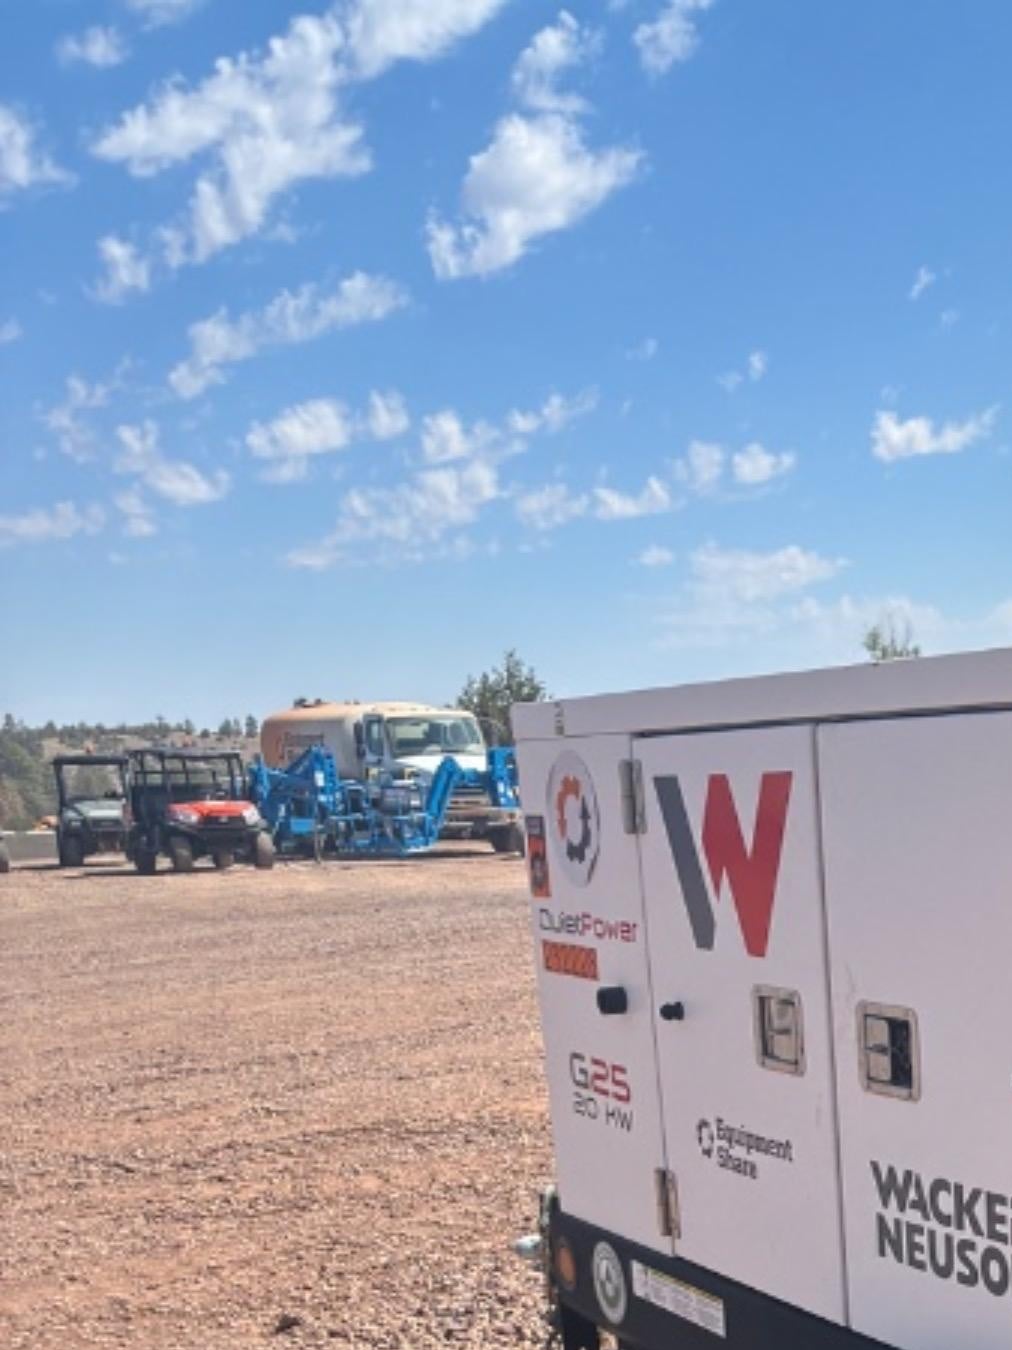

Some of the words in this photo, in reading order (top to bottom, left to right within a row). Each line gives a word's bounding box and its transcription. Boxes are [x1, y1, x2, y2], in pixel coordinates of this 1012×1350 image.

[569, 1051, 631, 1104] G25
[716, 1117, 793, 1162] Equipment
[717, 1145, 757, 1180] Share
